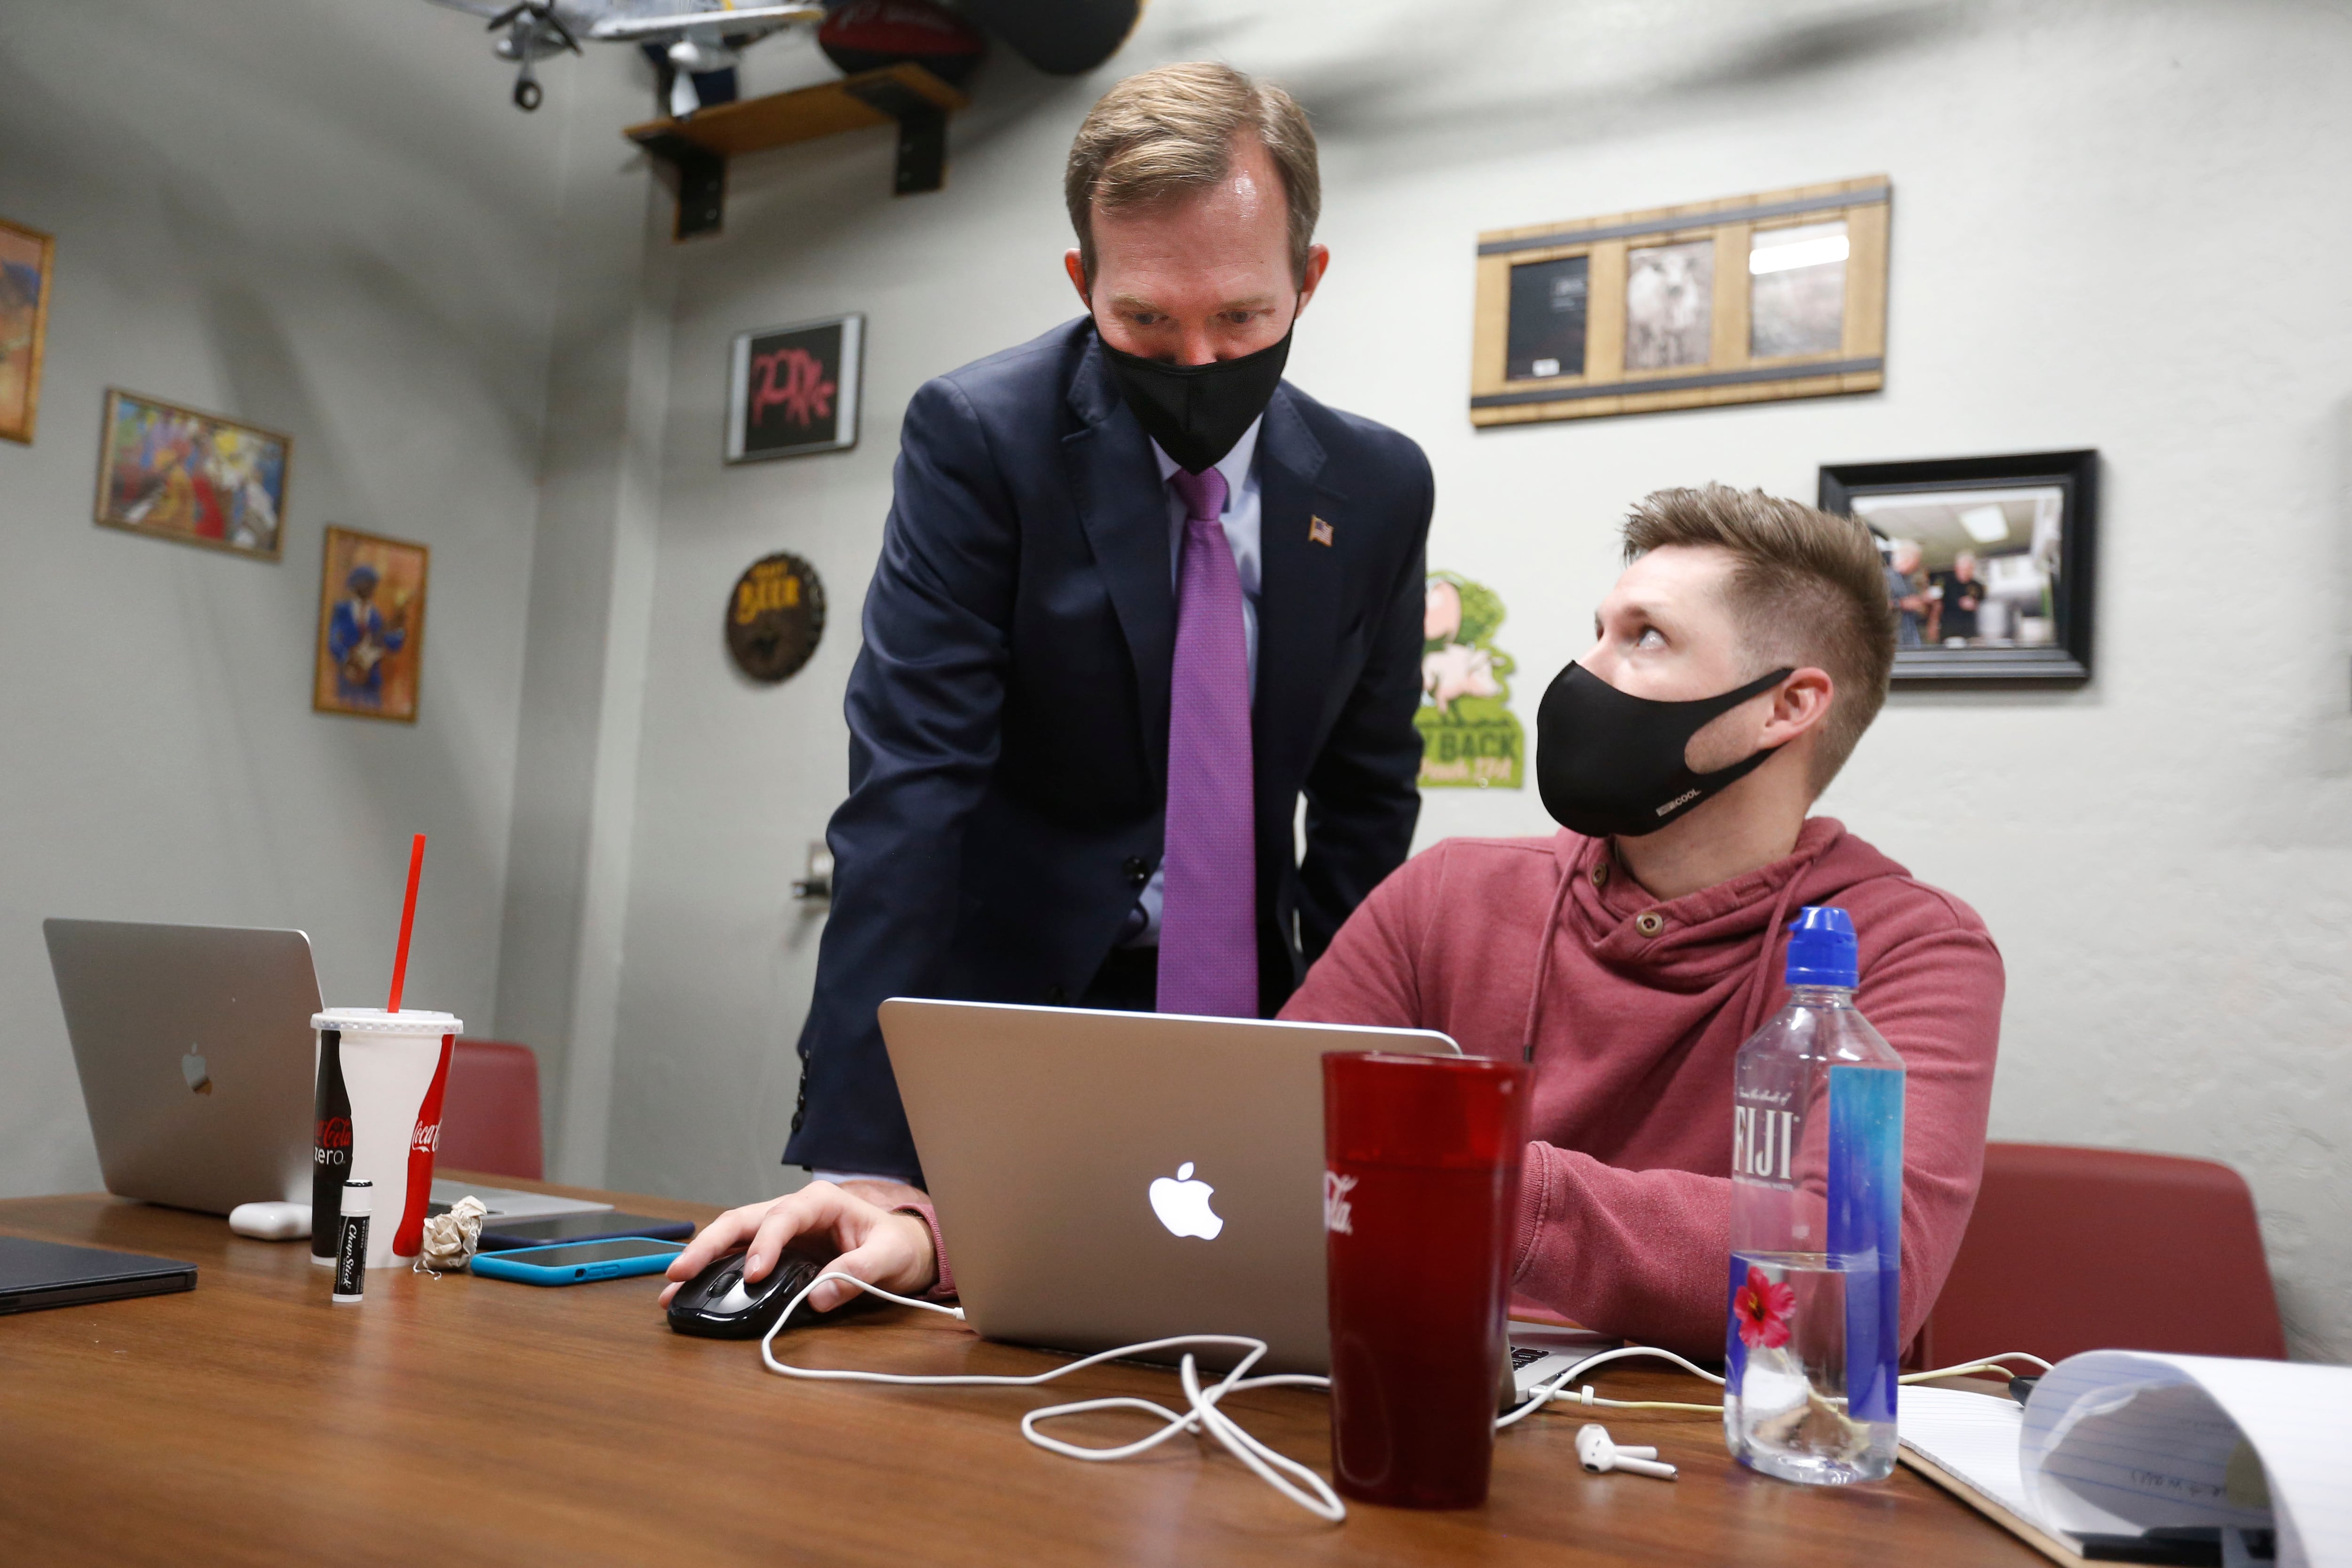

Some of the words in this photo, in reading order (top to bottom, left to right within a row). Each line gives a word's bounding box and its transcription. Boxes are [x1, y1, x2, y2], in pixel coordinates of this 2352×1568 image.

[314, 1146, 344, 1165] zero
[1733, 1106, 1794, 1179] FIJI
[342, 1224, 358, 1287] ChapStick
